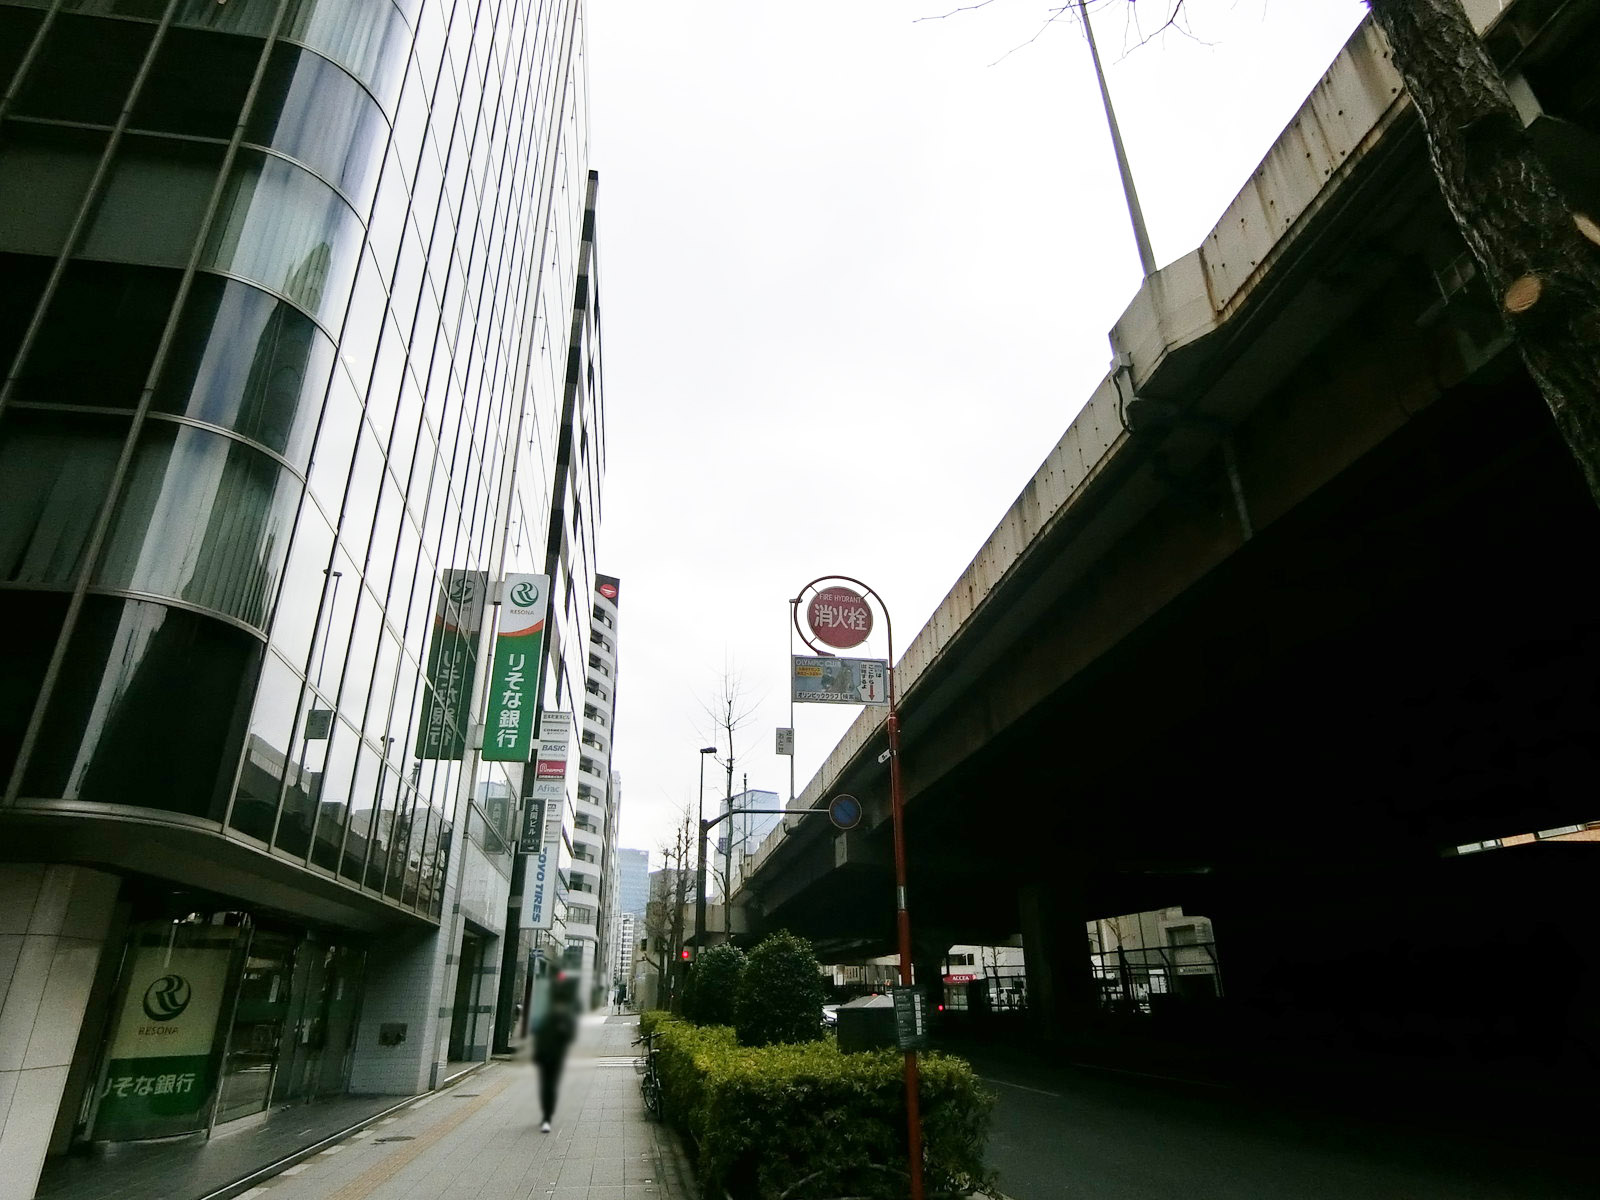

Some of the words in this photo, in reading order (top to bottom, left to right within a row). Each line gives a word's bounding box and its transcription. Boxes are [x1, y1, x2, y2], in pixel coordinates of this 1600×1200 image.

[819, 593, 833, 601] FIRE
[834, 594, 861, 604] HYDRANT
[509, 608, 535, 616] RESONA
[814, 603, 868, 631] 消火栓
[496, 653, 525, 748] りそな銀行
[542, 744, 566, 752] BASIC
[537, 784, 560, 792] Aflac
[536, 846, 548, 882] TOYO
[531, 882, 545, 923] TIRES
[138, 1026, 179, 1036] RESONA
